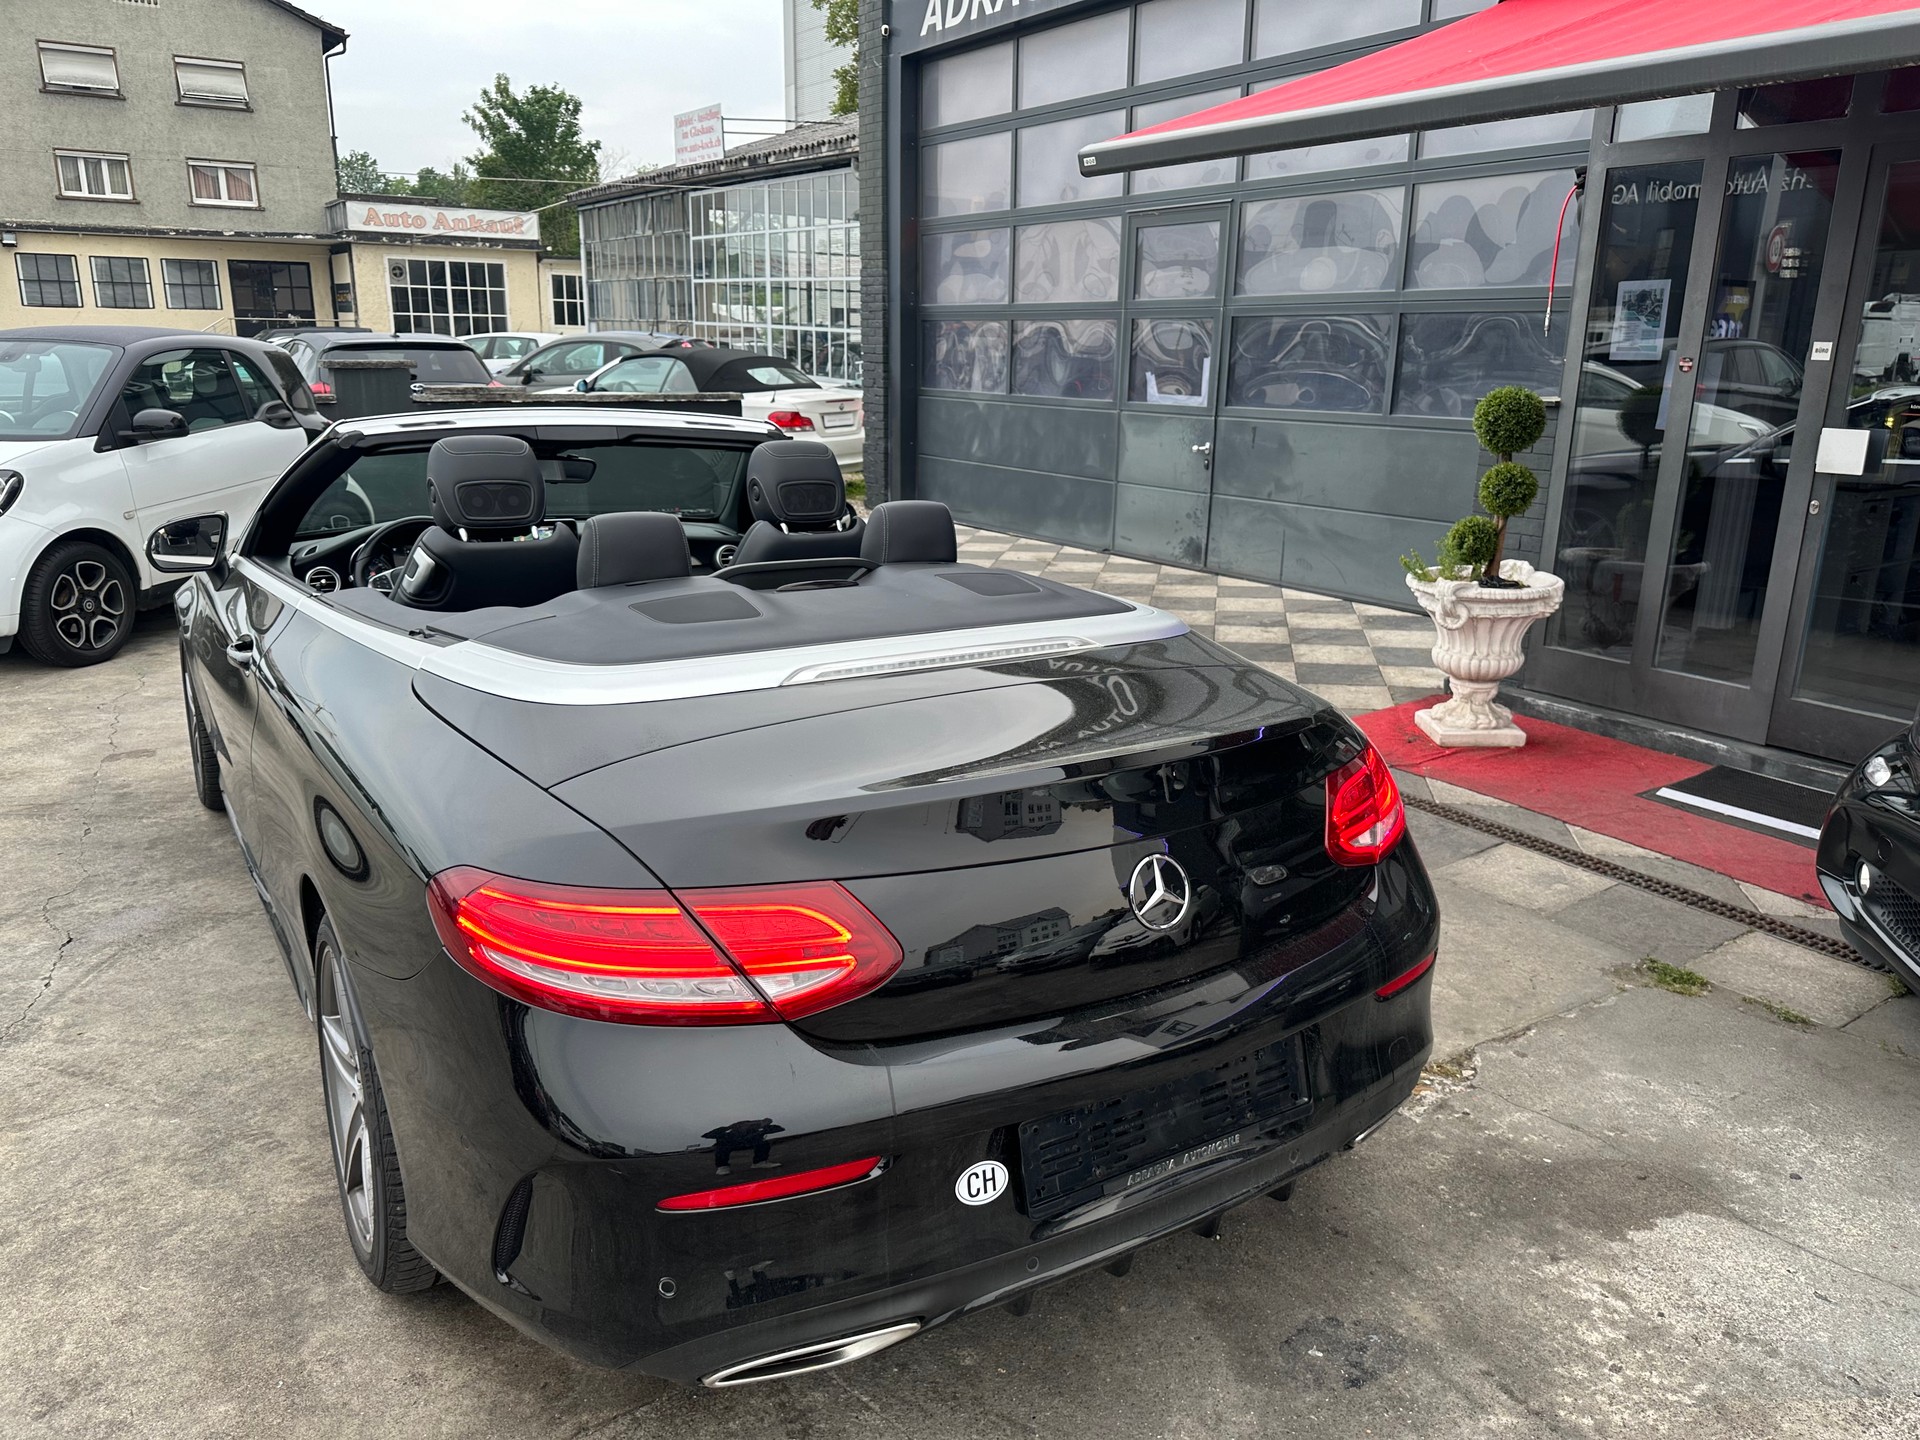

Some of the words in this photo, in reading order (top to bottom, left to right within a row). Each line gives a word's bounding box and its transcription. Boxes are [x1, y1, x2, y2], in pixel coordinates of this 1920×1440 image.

[363, 207, 427, 230] Auto
[432, 212, 525, 235] Ankauf
[1814, 346, 1829, 354] BÜRO
[1183, 1133, 1240, 1165] AUTOMOBILE
[967, 1166, 997, 1198] CH
